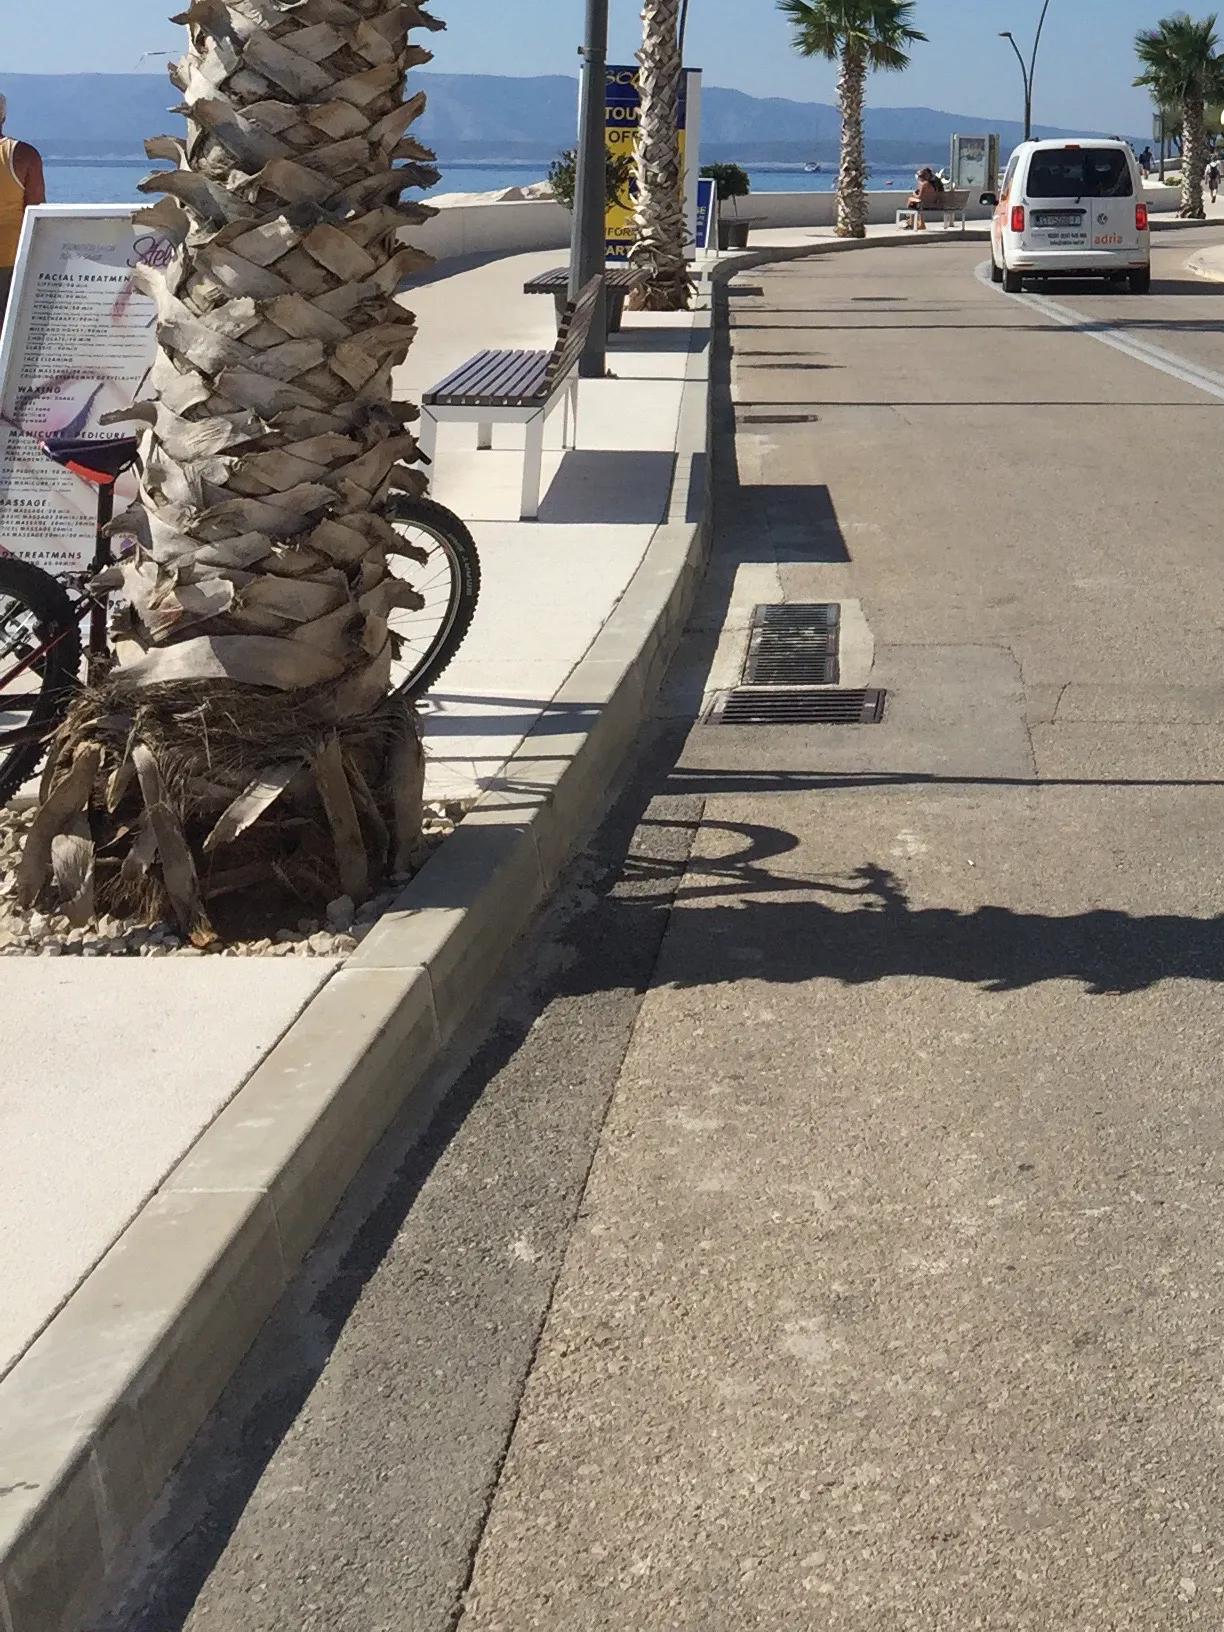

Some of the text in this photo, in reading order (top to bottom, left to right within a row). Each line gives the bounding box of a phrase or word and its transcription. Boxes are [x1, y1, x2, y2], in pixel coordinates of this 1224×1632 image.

[604, 106, 640, 120] TOU
[608, 131, 640, 143] OFF
[1094, 232, 1123, 245] adria
[38, 272, 130, 282] FACIAL TREATMEN
[17, 385, 62, 394] WAXING
[19, 551, 82, 560] TREATMANS
